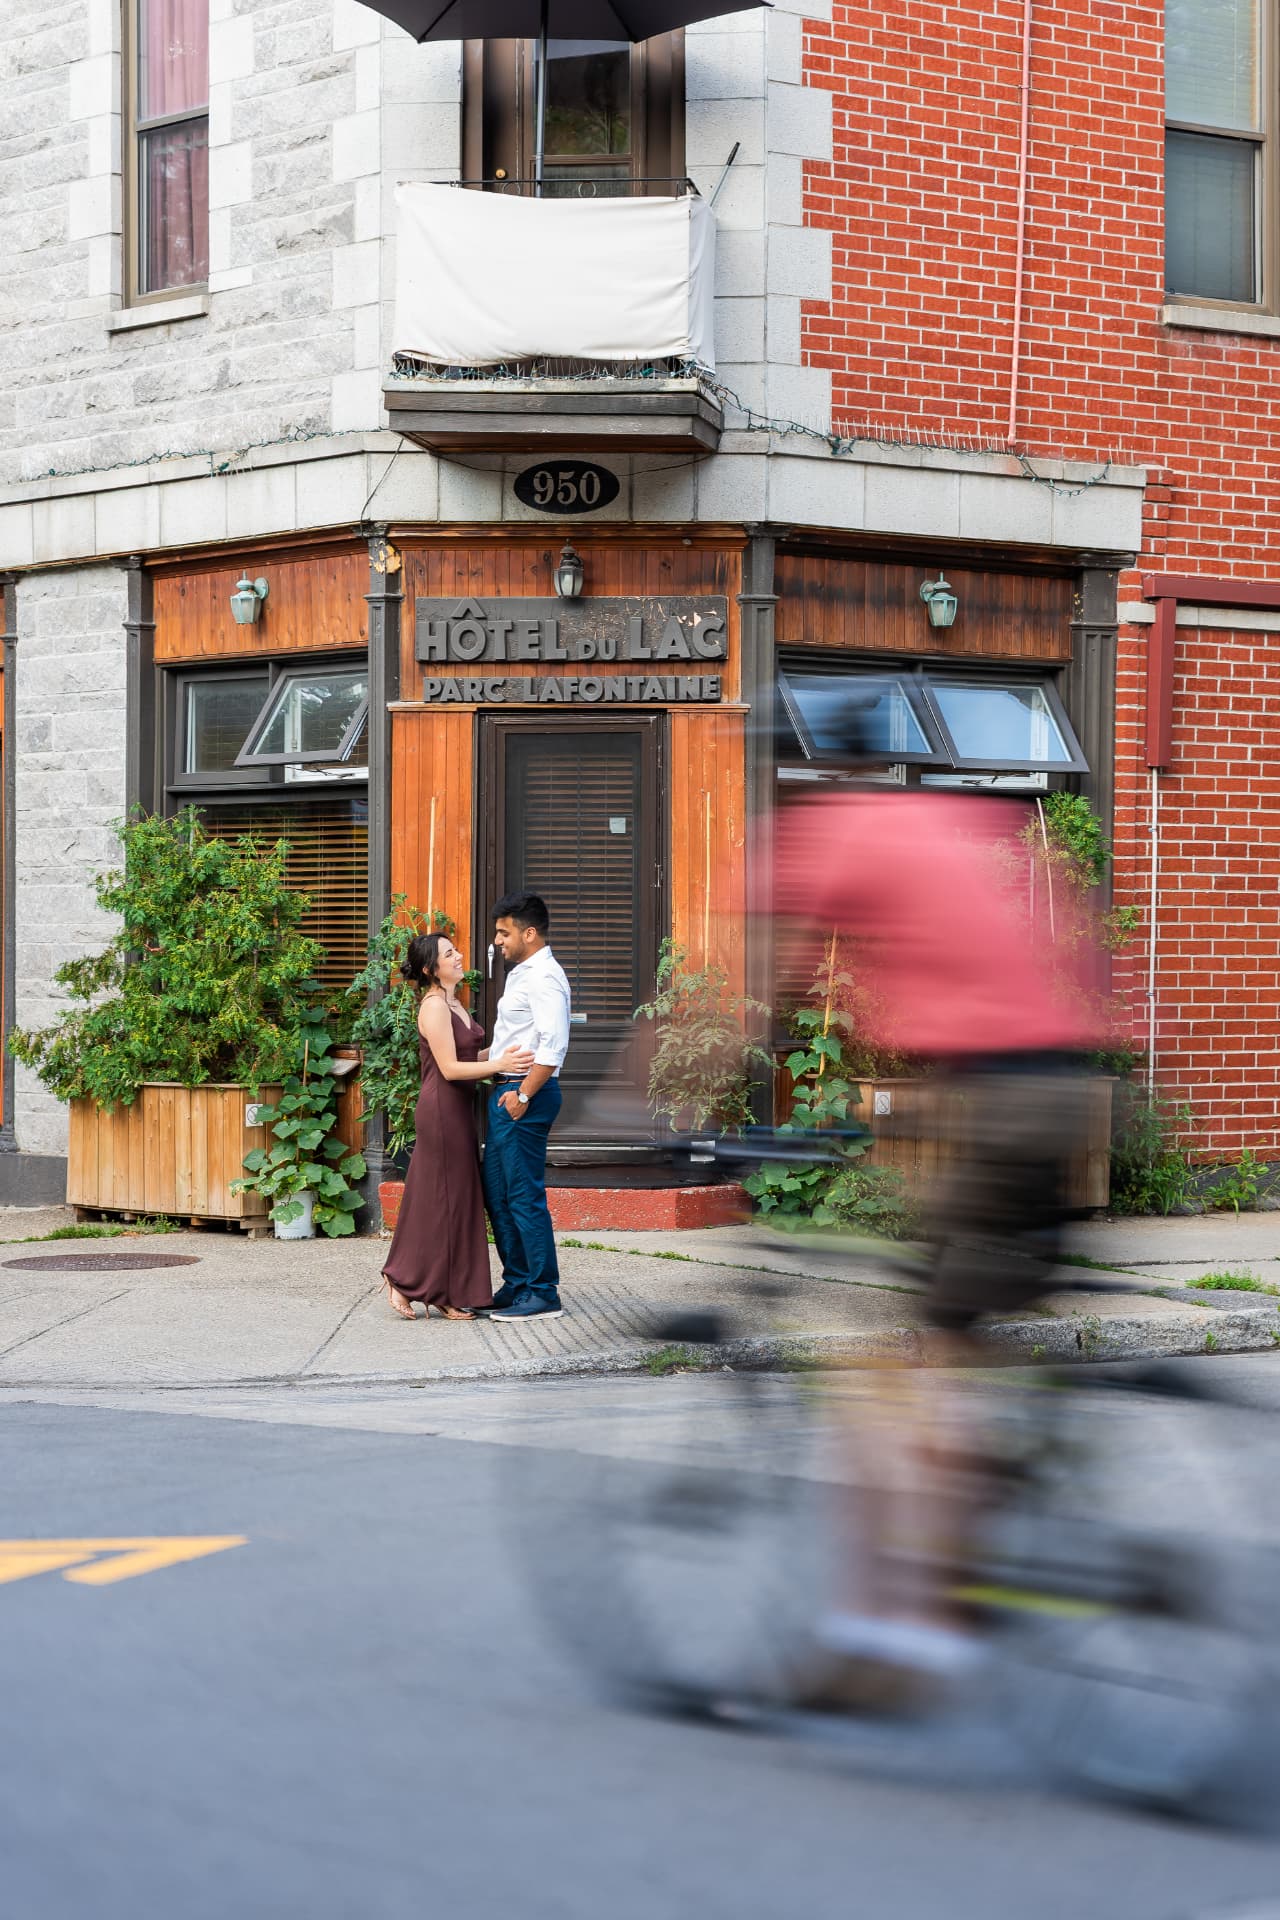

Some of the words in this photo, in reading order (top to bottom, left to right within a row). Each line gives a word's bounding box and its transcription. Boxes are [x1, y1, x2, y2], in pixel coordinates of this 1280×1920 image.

[533, 470, 601, 505] 950
[419, 598, 569, 661] HÔTEL
[577, 639, 618, 660] DU
[629, 616, 725, 660] LAC
[424, 678, 506, 702] PARC
[523, 677, 720, 701] LAFONTAINE
